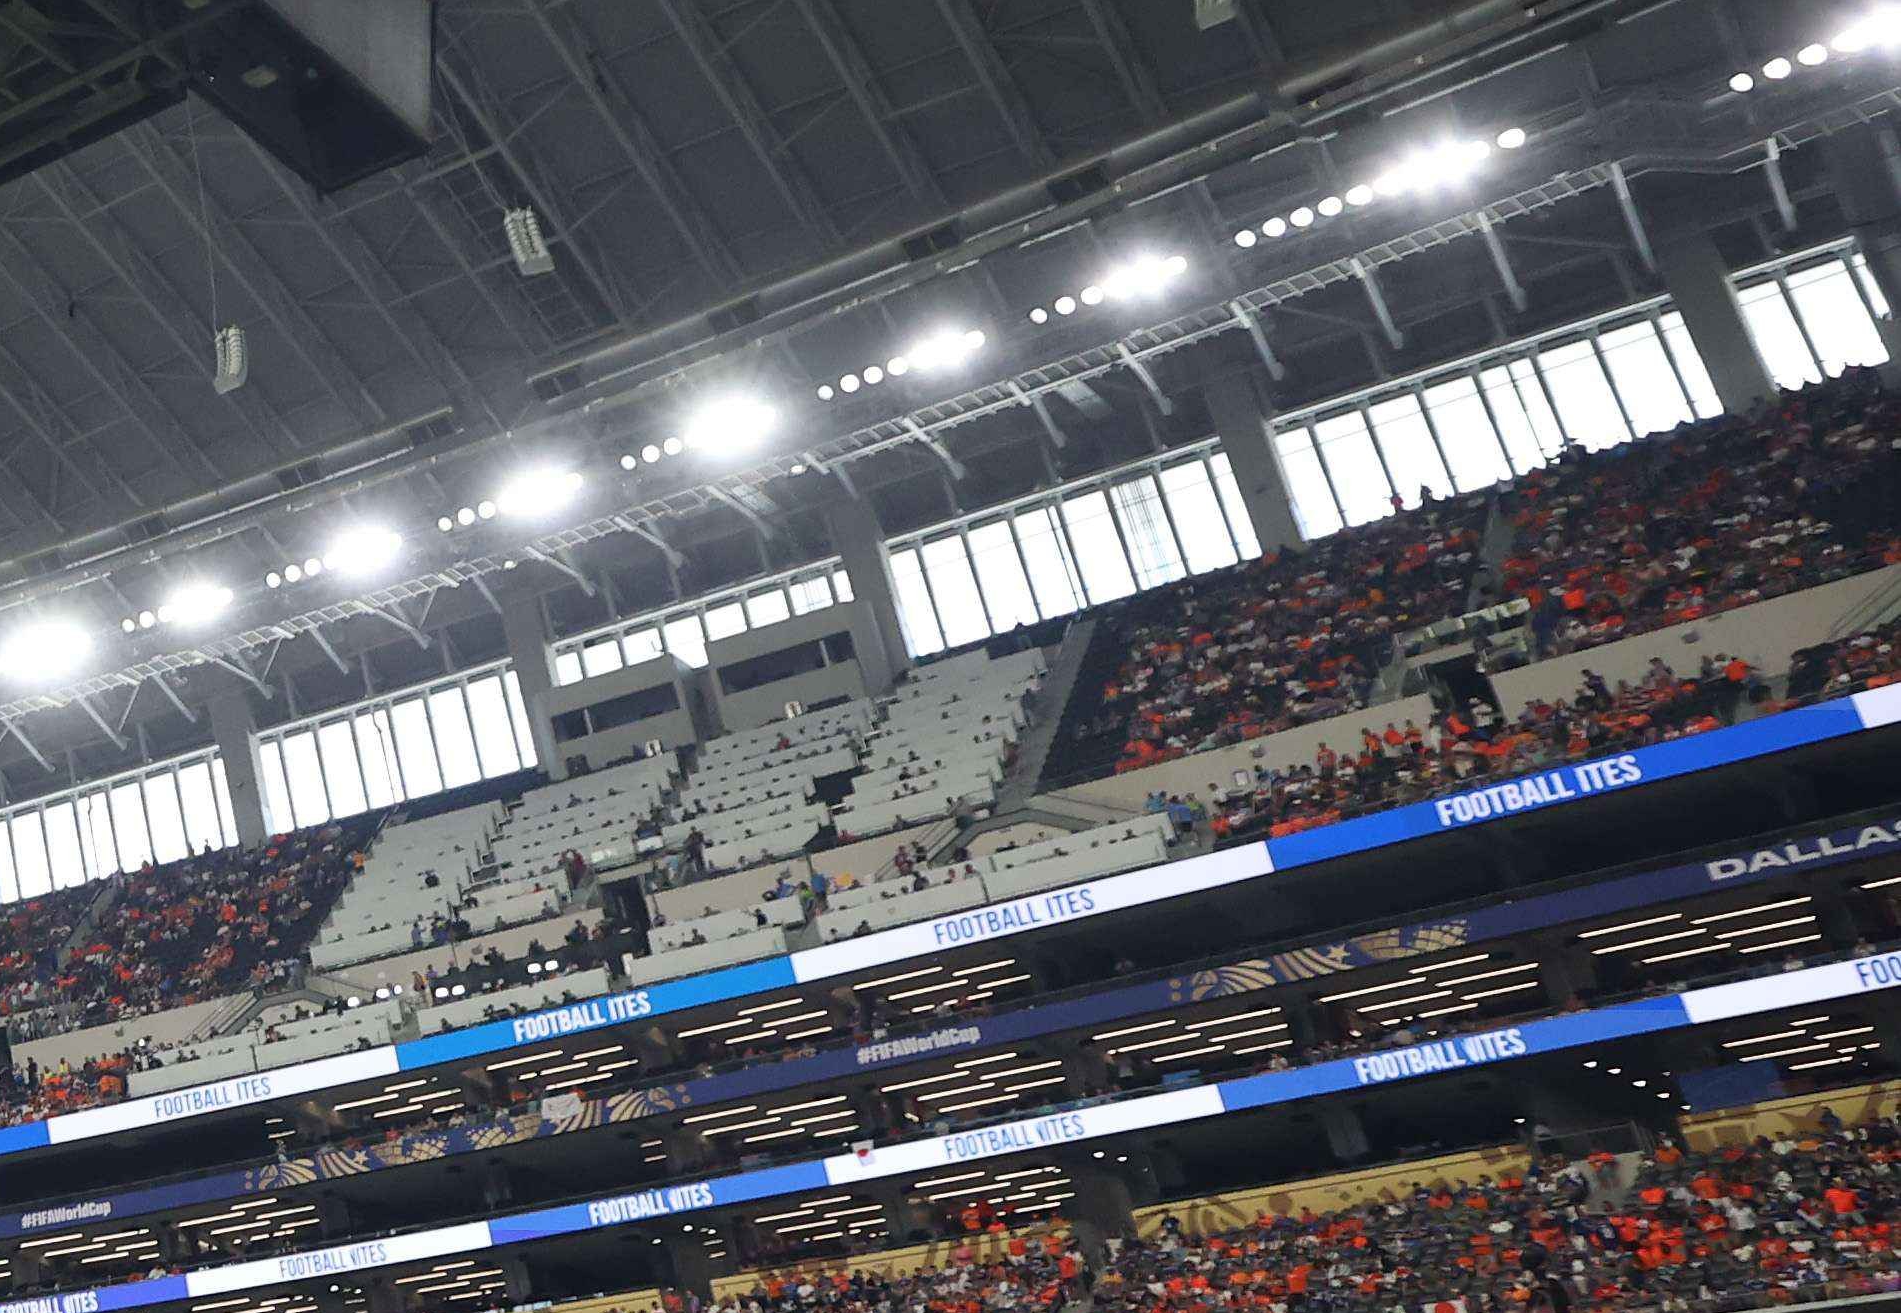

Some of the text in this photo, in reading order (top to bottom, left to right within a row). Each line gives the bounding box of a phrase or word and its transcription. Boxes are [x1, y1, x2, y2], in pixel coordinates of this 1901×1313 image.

[1437, 773, 1574, 826] FOOTBALL
[934, 902, 1041, 943] FOOTBALL
[514, 1001, 604, 1043] FOOTBALL
[857, 1024, 981, 1065] #FIFAWorldCup
[1354, 1041, 1466, 1084] FOOTBALL
[155, 1088, 231, 1117] FOOTBALL
[945, 1126, 1032, 1160] FOOTBALL
[22, 1200, 111, 1230] #FIFAWorldCup
[589, 1191, 668, 1225] FOOTBALL
[280, 1250, 347, 1277] FOOTBALL
